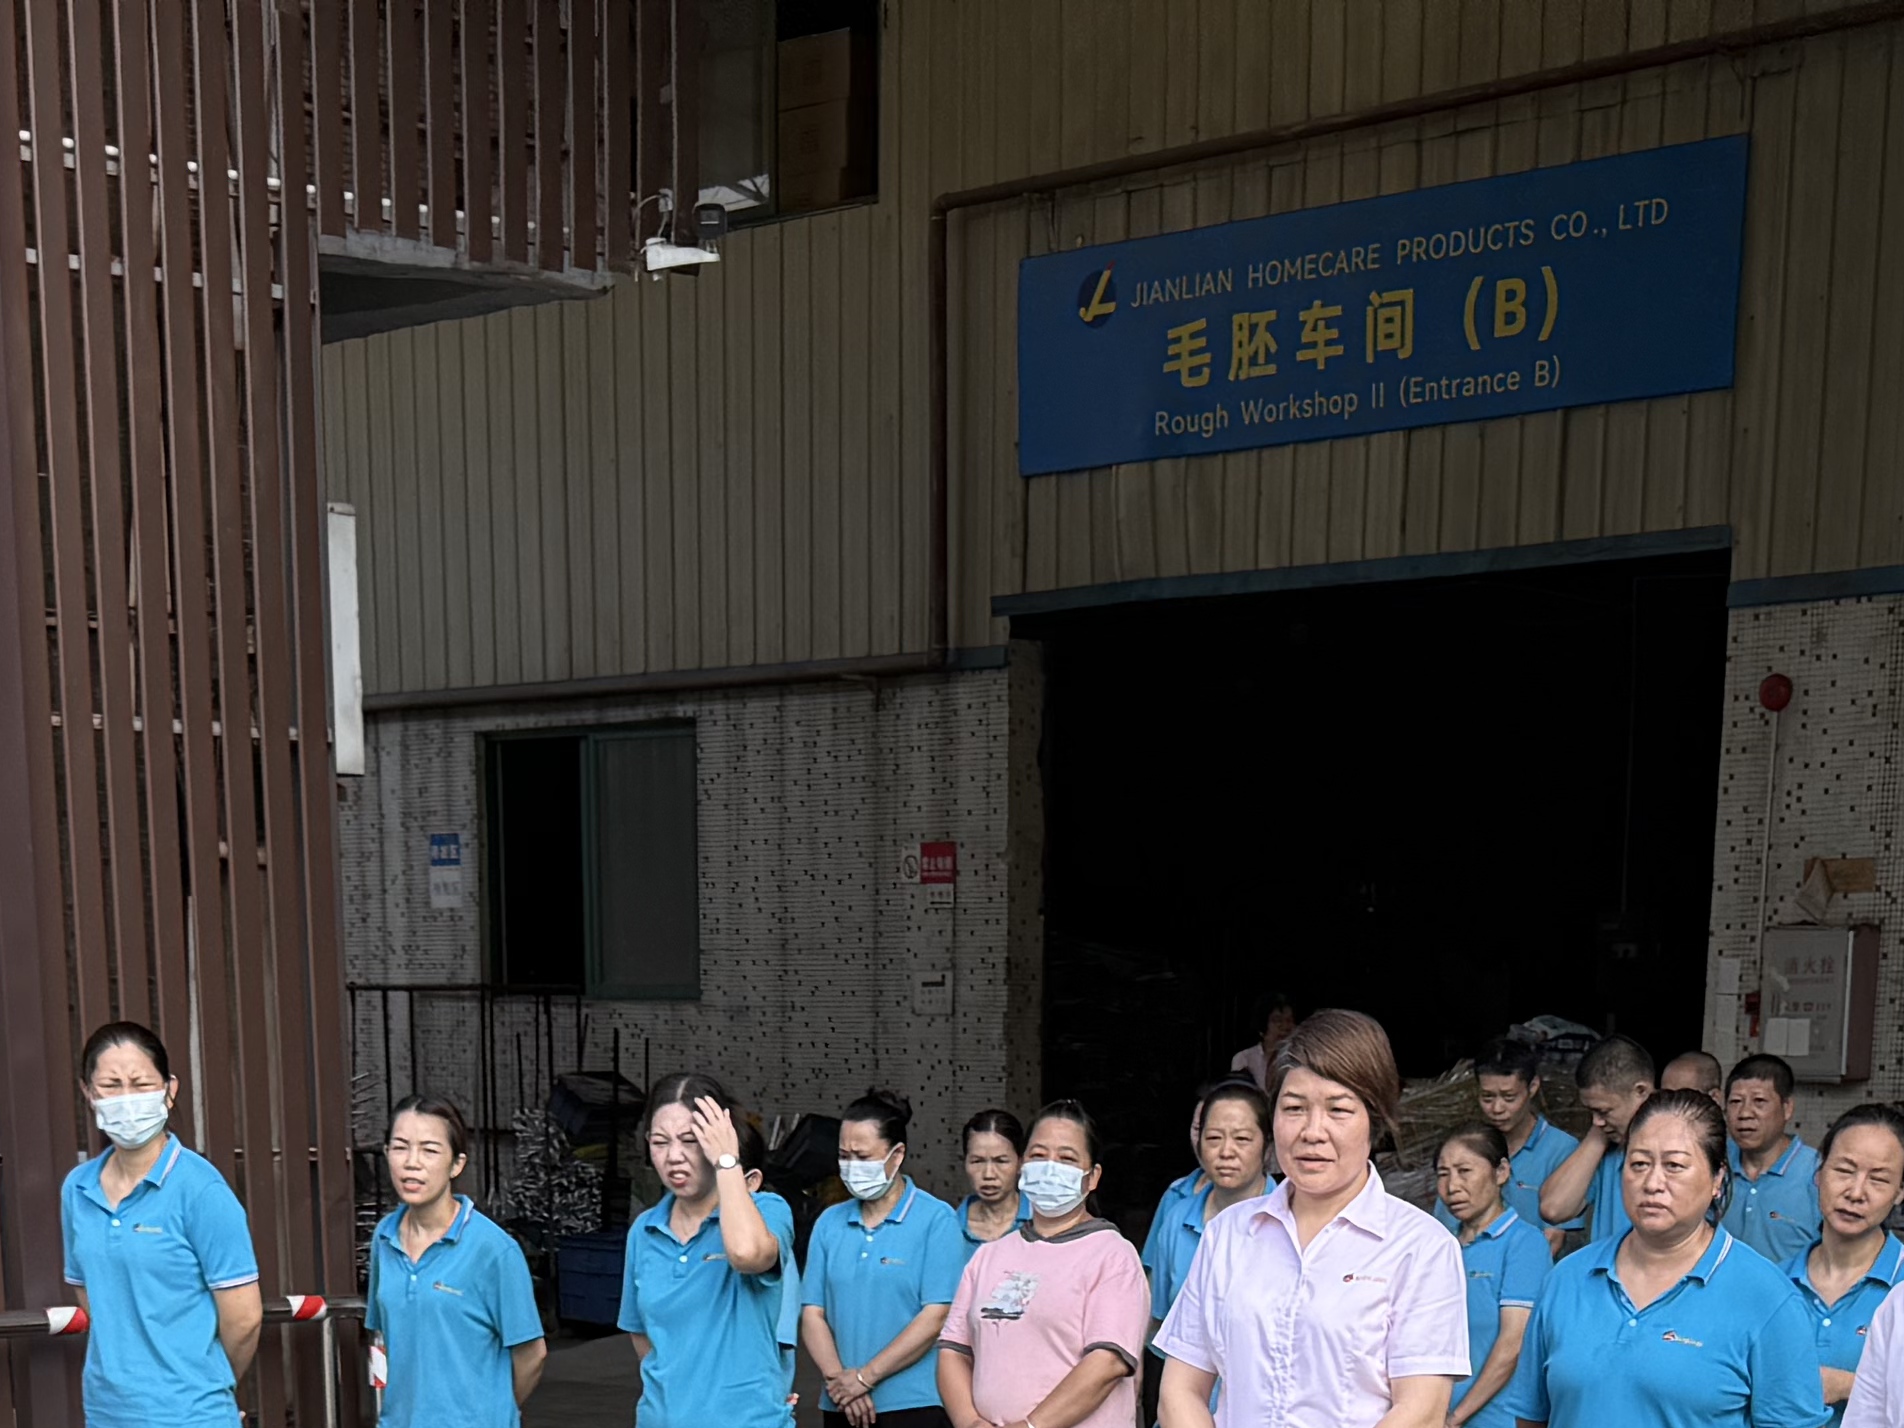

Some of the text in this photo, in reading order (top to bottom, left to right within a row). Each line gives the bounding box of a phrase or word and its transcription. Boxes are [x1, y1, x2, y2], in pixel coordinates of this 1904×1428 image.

[1130, 268, 1233, 309] JIANLIAN
[1247, 243, 1381, 289] HOMECARE
[1397, 218, 1535, 265] PRODUCTS
[1618, 198, 1669, 230] LTD
[1154, 403, 1230, 438] Rough
[1240, 390, 1359, 424] Workshop
[1399, 376, 1521, 408] (Entrance
[1533, 355, 1560, 389] B)
